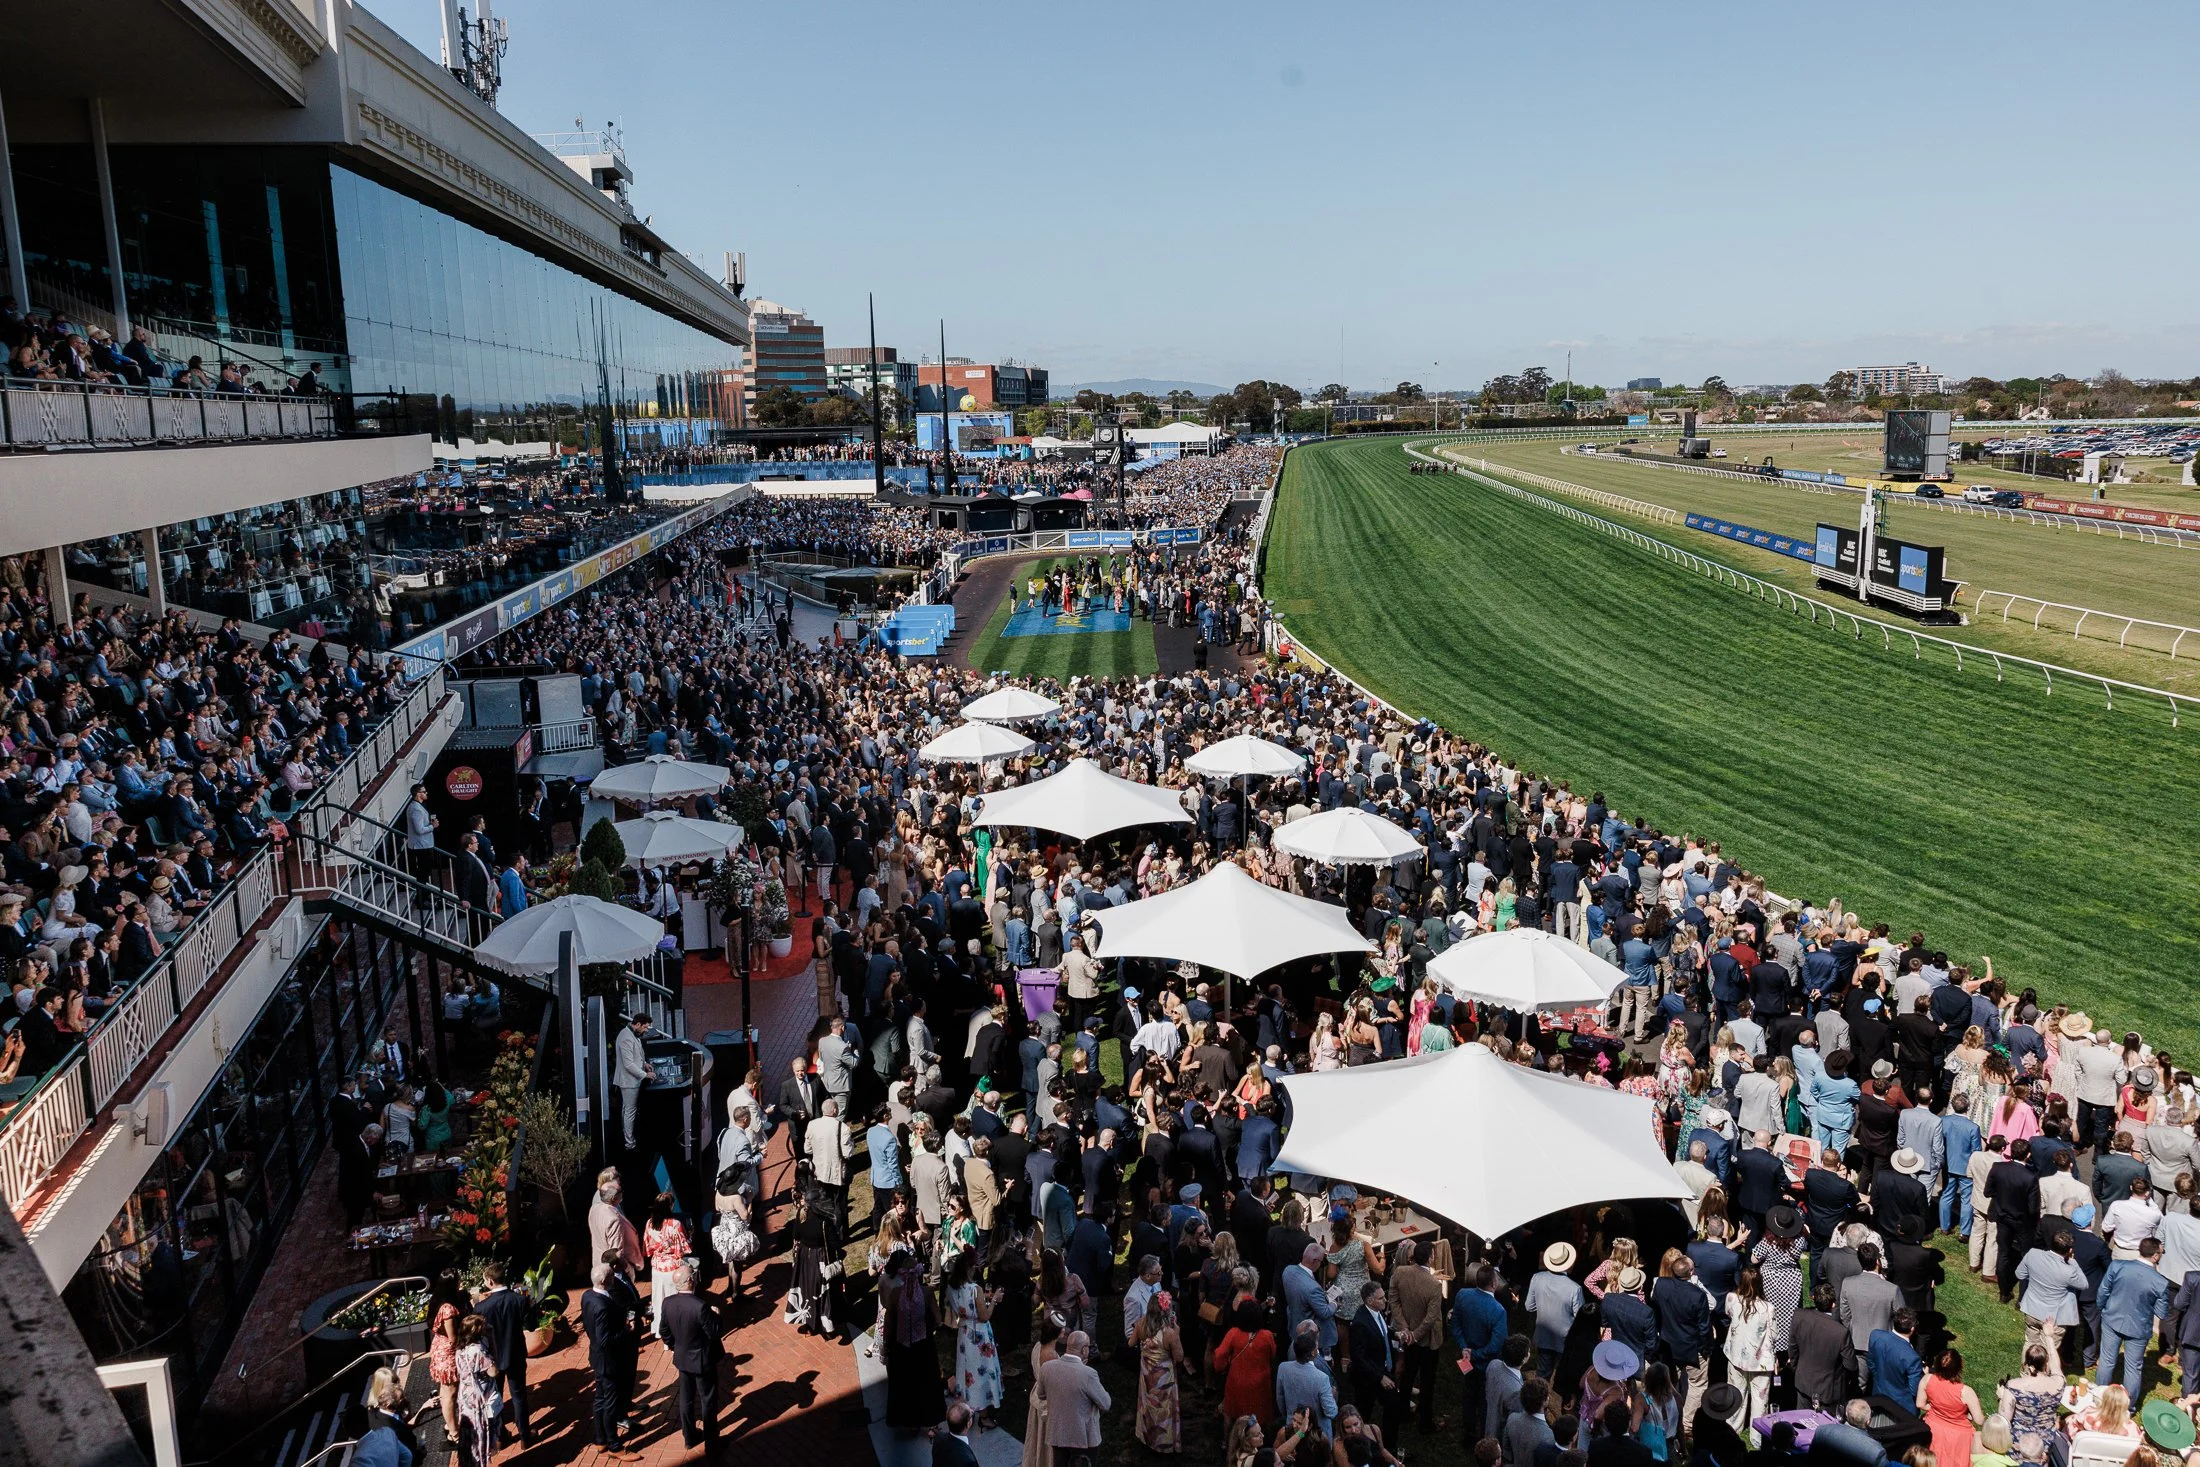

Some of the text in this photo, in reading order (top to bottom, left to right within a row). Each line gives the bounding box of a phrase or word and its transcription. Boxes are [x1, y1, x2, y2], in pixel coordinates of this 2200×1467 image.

[1900, 563, 1926, 577] sportsbet
[513, 597, 531, 621] sportsbet
[886, 637, 926, 647] sportsbet
[682, 851, 708, 859] CHANDON
